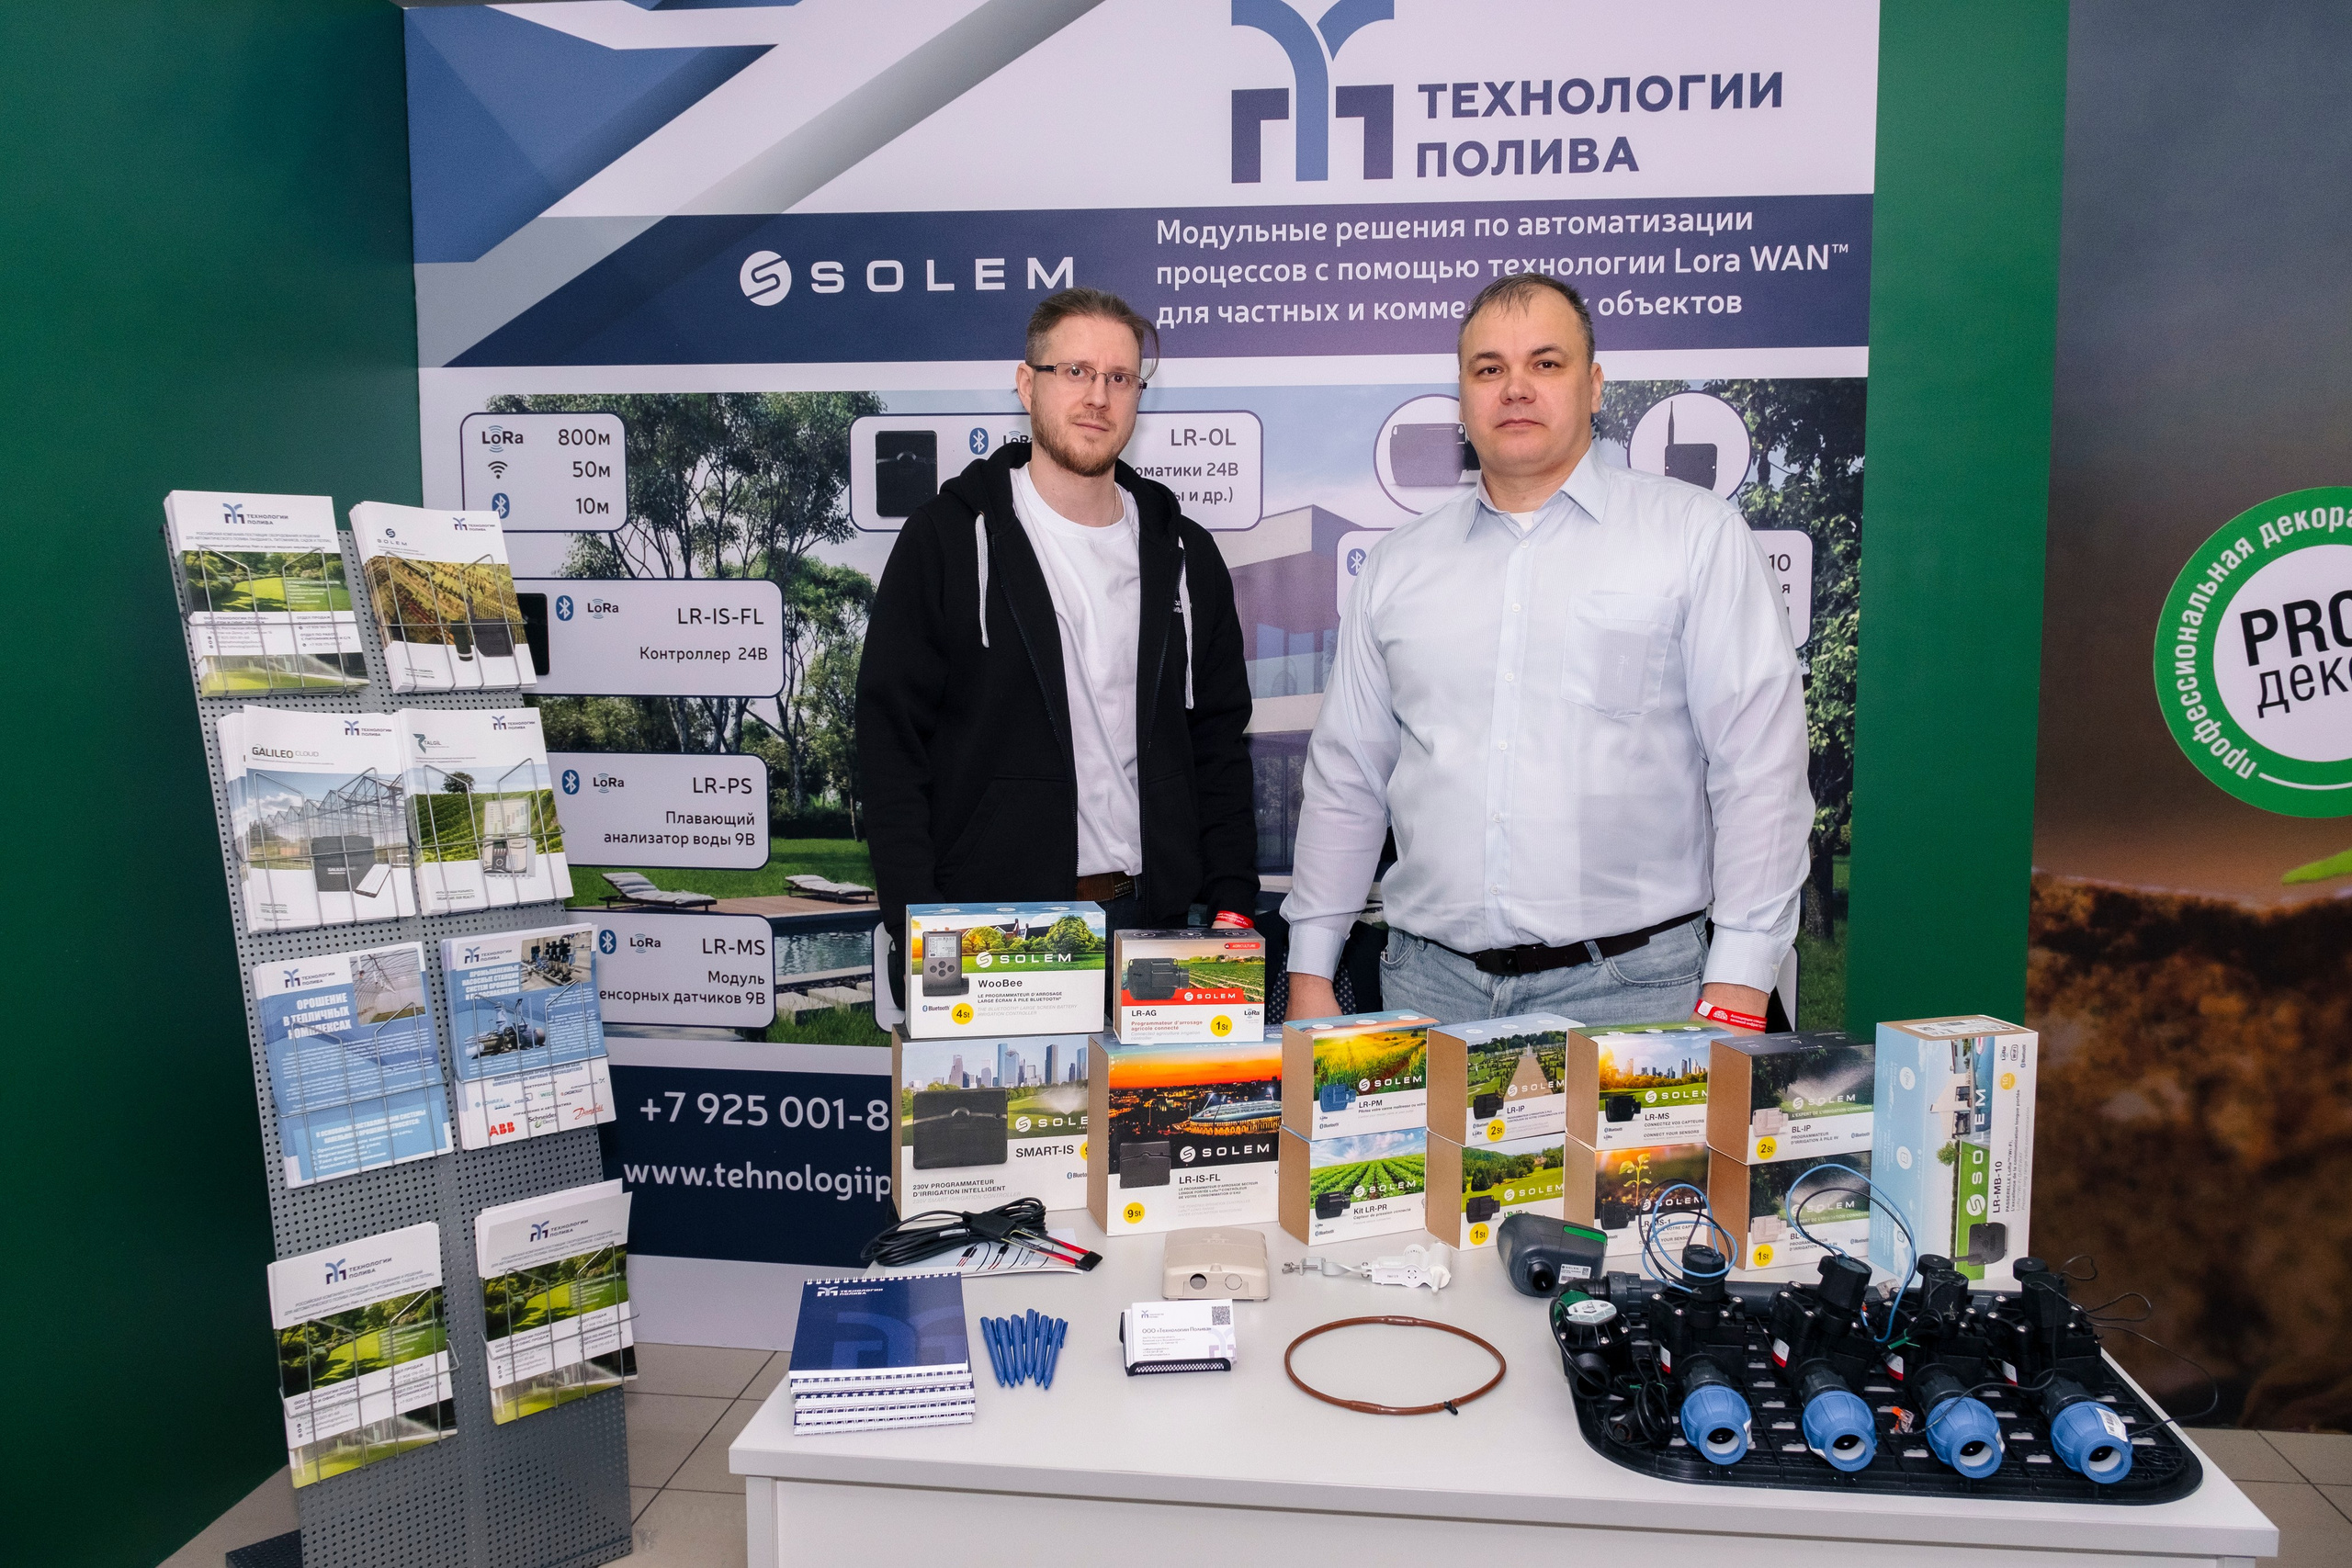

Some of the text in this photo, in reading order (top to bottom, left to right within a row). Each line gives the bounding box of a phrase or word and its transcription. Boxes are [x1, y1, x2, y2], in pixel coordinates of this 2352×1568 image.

[1418, 71, 1784, 118] ТЕХНОЛОГИИ
[1418, 135, 1639, 179] ПОЛИВА
[1157, 210, 1753, 251] Модульные решения по автоматизации
[1157, 259, 1306, 287] процессов
[1315, 261, 1328, 282] с
[1338, 255, 1479, 283] помощью
[1488, 249, 1665, 276] технологии
[1675, 246, 1740, 275] Lora
[810, 256, 1074, 294] SOLEM
[1157, 300, 1208, 329] для
[1218, 298, 1338, 323] частных
[1348, 299, 1364, 320] и
[1598, 287, 1742, 316] объектов
[481, 429, 610, 446] LoRa 800м
[1170, 428, 1237, 446] LR-OL
[572, 461, 611, 478] 50м
[1134, 466, 1202, 477] оматики
[1190, 491, 1198, 502] и
[1202, 486, 1233, 505] др.)
[575, 498, 609, 514] 10м
[377, 538, 408, 547] SOLEM
[587, 603, 764, 626] LoRa LR-IS-FL
[639, 647, 730, 663] Контроллер
[2175, 536, 2258, 780] профессиональная
[2256, 656, 2352, 718] дек
[252, 746, 294, 759] GALILEO
[593, 777, 752, 795] LoRa LR-PS
[665, 811, 755, 827] Плавающий
[604, 832, 689, 848] анализатор
[693, 833, 731, 848] воды
[630, 937, 765, 956] LoRa LR-MS
[1000, 953, 1072, 964] SOLEM
[708, 971, 765, 987] Модуль
[978, 979, 1023, 988] WooBee
[297, 993, 347, 1010] ОРОШЕНИЕ
[599, 989, 669, 1003] енсорных
[673, 992, 741, 1004] датчиков
[290, 1006, 350, 1023] ТЕПЛИЧНЫХ
[1374, 1075, 1422, 1087] SOLEM
[1521, 1080, 1565, 1092] SOLEM
[1359, 1100, 1383, 1109] LR-PM
[1808, 1093, 1856, 1106] SOLEM
[640, 1091, 889, 1132] +7 925 001-8
[1507, 1105, 1525, 1114] LR-IP
[1645, 1112, 1669, 1121] LR-MS
[1038, 1115, 1088, 1128] SOLE
[1792, 1124, 1812, 1134] BL-IP
[489, 1122, 515, 1137] ABB
[1972, 1089, 1986, 1185] SOLEM
[1015, 1145, 1074, 1157] SMART-IS
[1202, 1144, 1270, 1157] SOLEM
[623, 1161, 891, 1202] www.tehnologiip
[932, 1179, 995, 1189] PROGRAMMATEUR
[1179, 1174, 1221, 1185] LR-IS-FL
[1369, 1180, 1416, 1193] SOLEM
[1993, 1161, 2003, 1213] LR-MB-10
[913, 1186, 1006, 1197] D'IRRIGATION INTELLIGENT
[1519, 1184, 1564, 1197] SOLEM
[1353, 1204, 1387, 1215] Kit LR-PR
[1807, 1201, 1855, 1213] SOLEM
[549, 1228, 574, 1237] ПОЛИВА
[551, 1220, 589, 1232] ТЕХНОЛОГИИ
[349, 1257, 392, 1272] ТЕХНОЛОГИИ
[349, 1268, 376, 1280] ПОЛИВА
